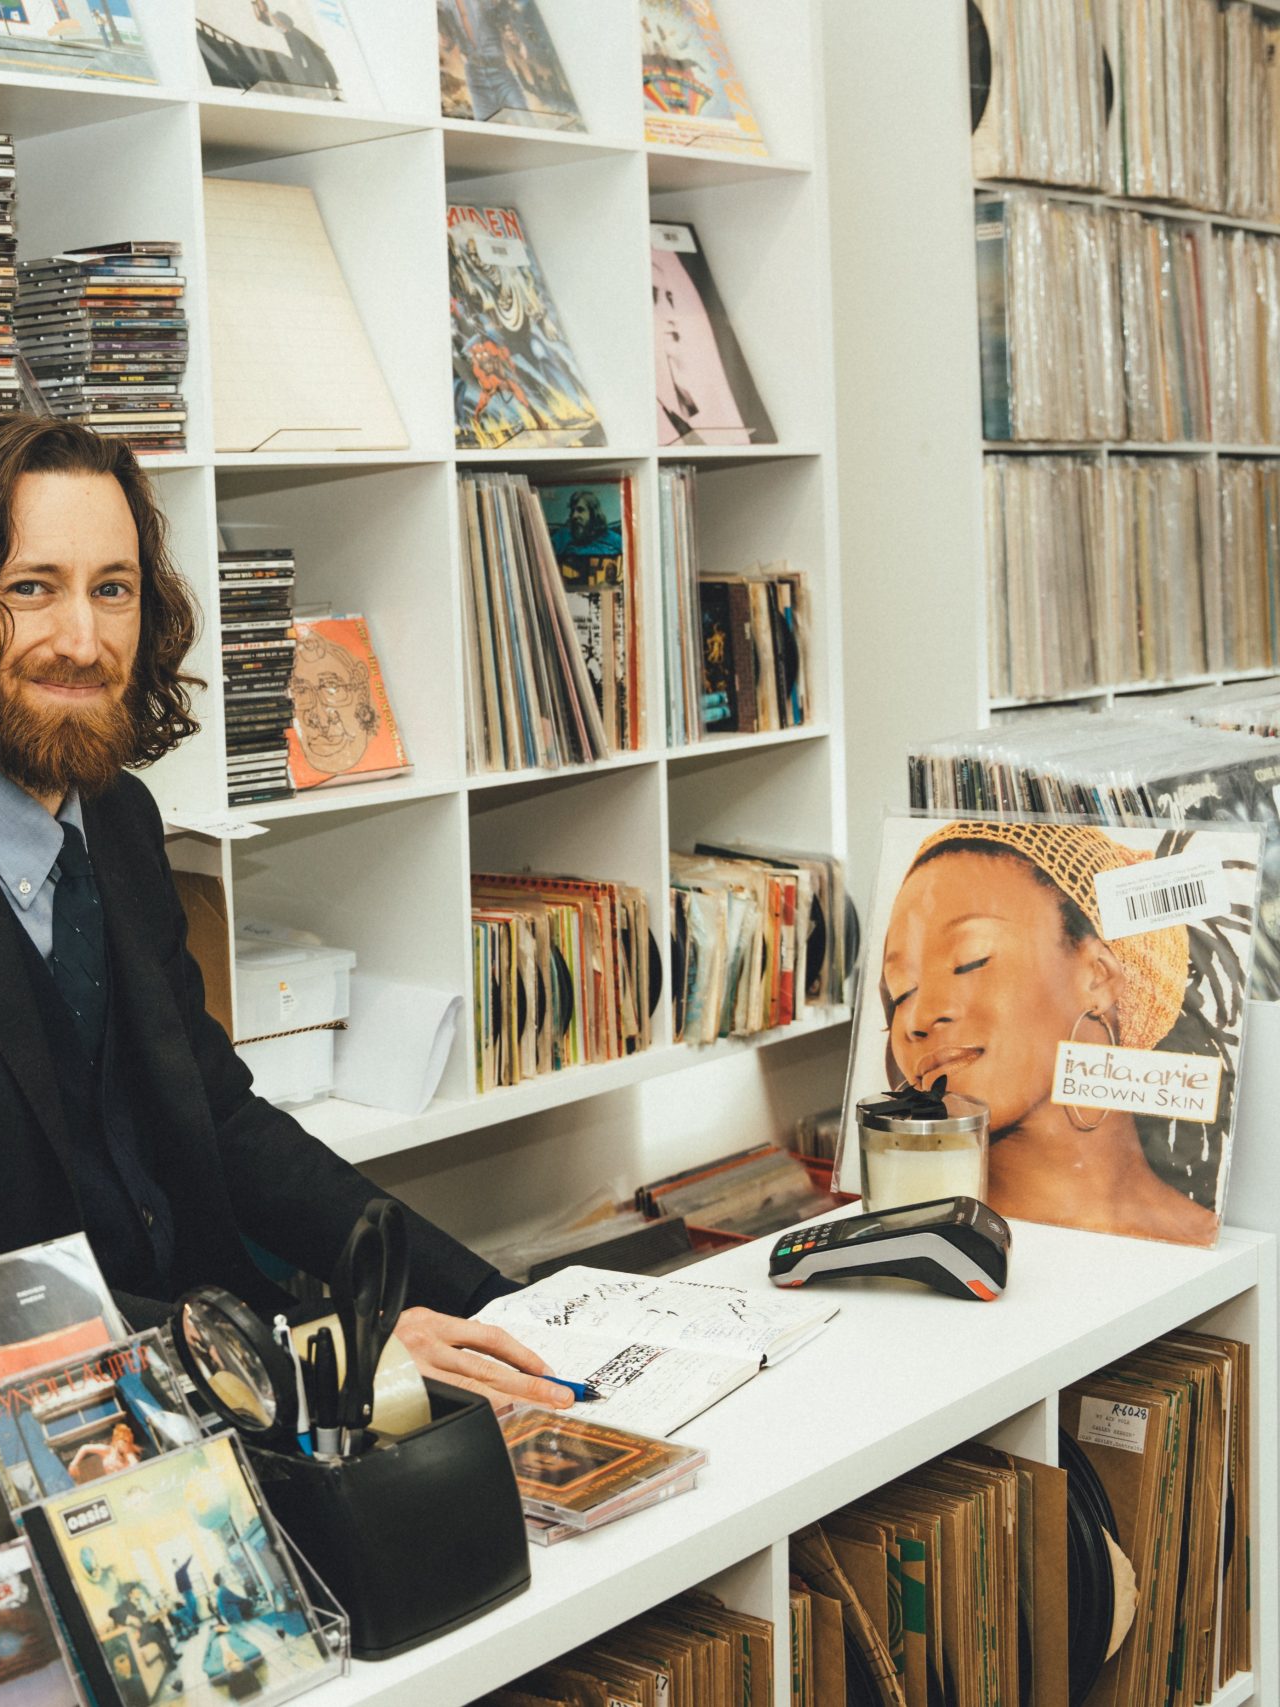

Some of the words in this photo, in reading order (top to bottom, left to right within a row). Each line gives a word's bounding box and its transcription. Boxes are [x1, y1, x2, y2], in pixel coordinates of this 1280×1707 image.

[1064, 1050, 1209, 1090] india.arie
[63, 1345, 151, 1392] LAUPER
[1111, 1403, 1147, 1420] R-6028
[67, 1502, 109, 1530] oasis
